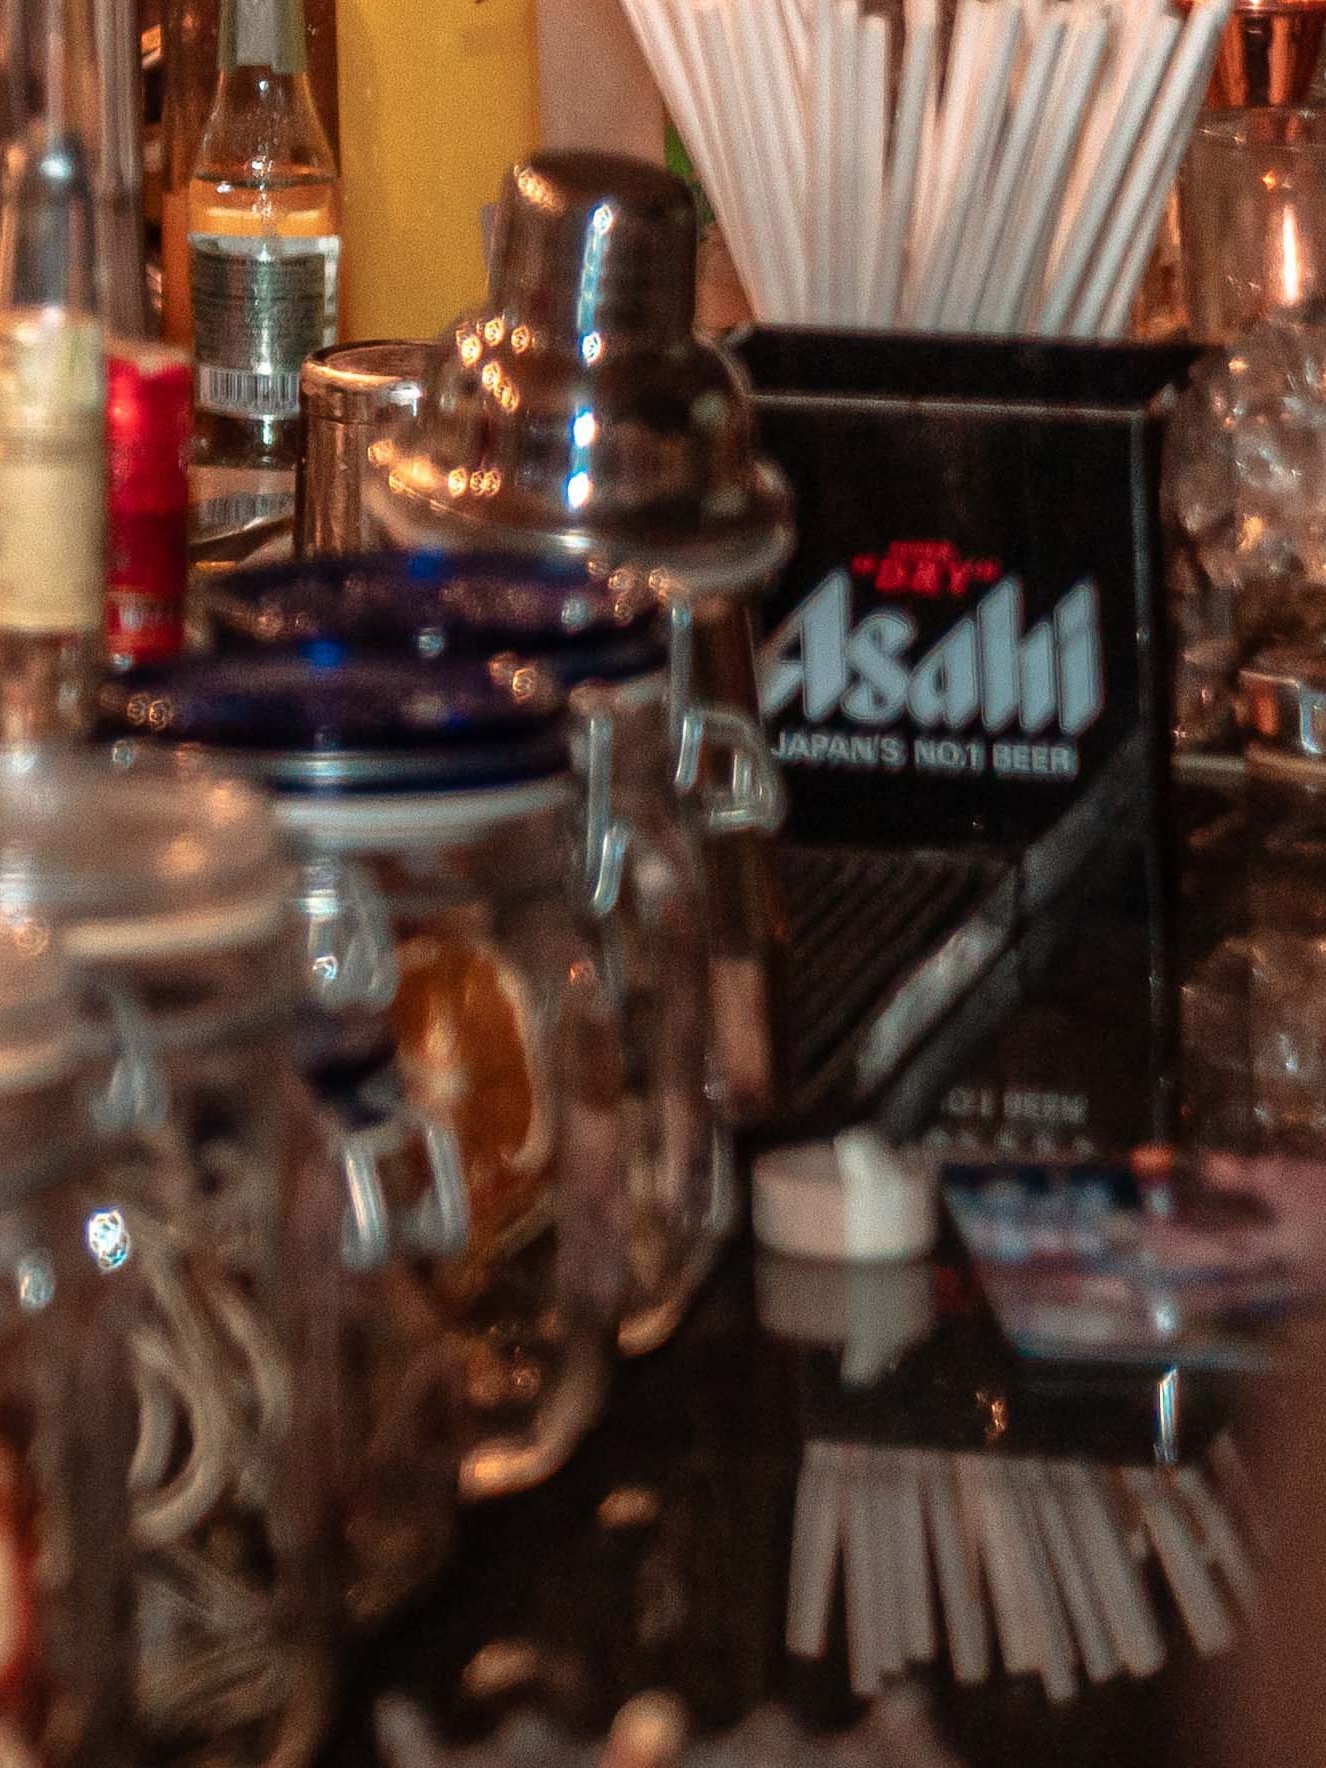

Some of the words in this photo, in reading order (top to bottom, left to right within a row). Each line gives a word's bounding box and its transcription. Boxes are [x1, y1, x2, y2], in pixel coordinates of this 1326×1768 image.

[752, 568, 1102, 735] Asahi
[771, 729, 906, 764] JAPAN'S
[992, 741, 1078, 780] BEER
